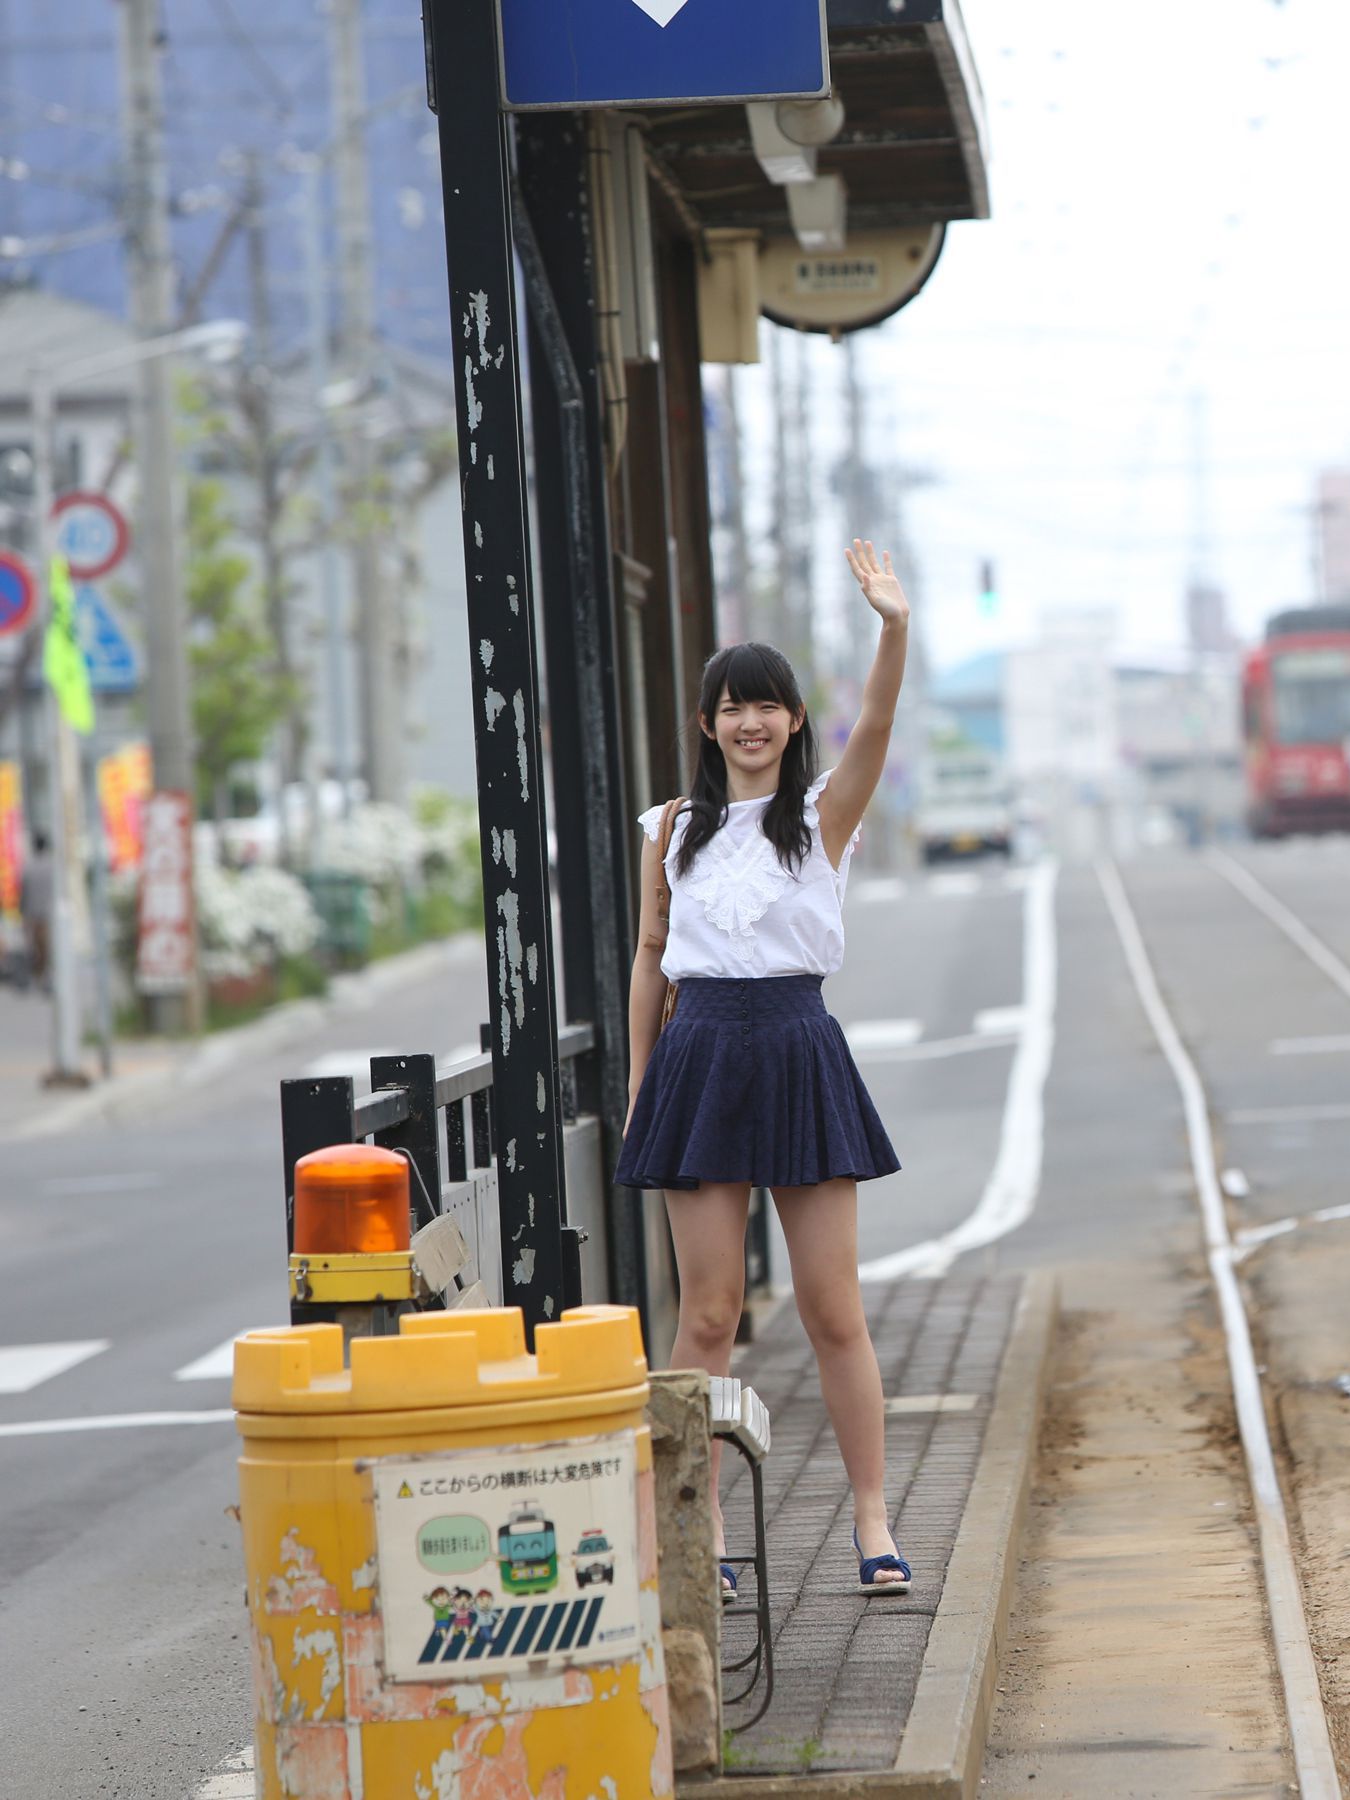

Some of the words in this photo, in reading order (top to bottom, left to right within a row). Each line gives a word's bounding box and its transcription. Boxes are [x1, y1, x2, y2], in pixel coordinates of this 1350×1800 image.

[419, 1457, 622, 1497] ここからの横断は大変危険です
